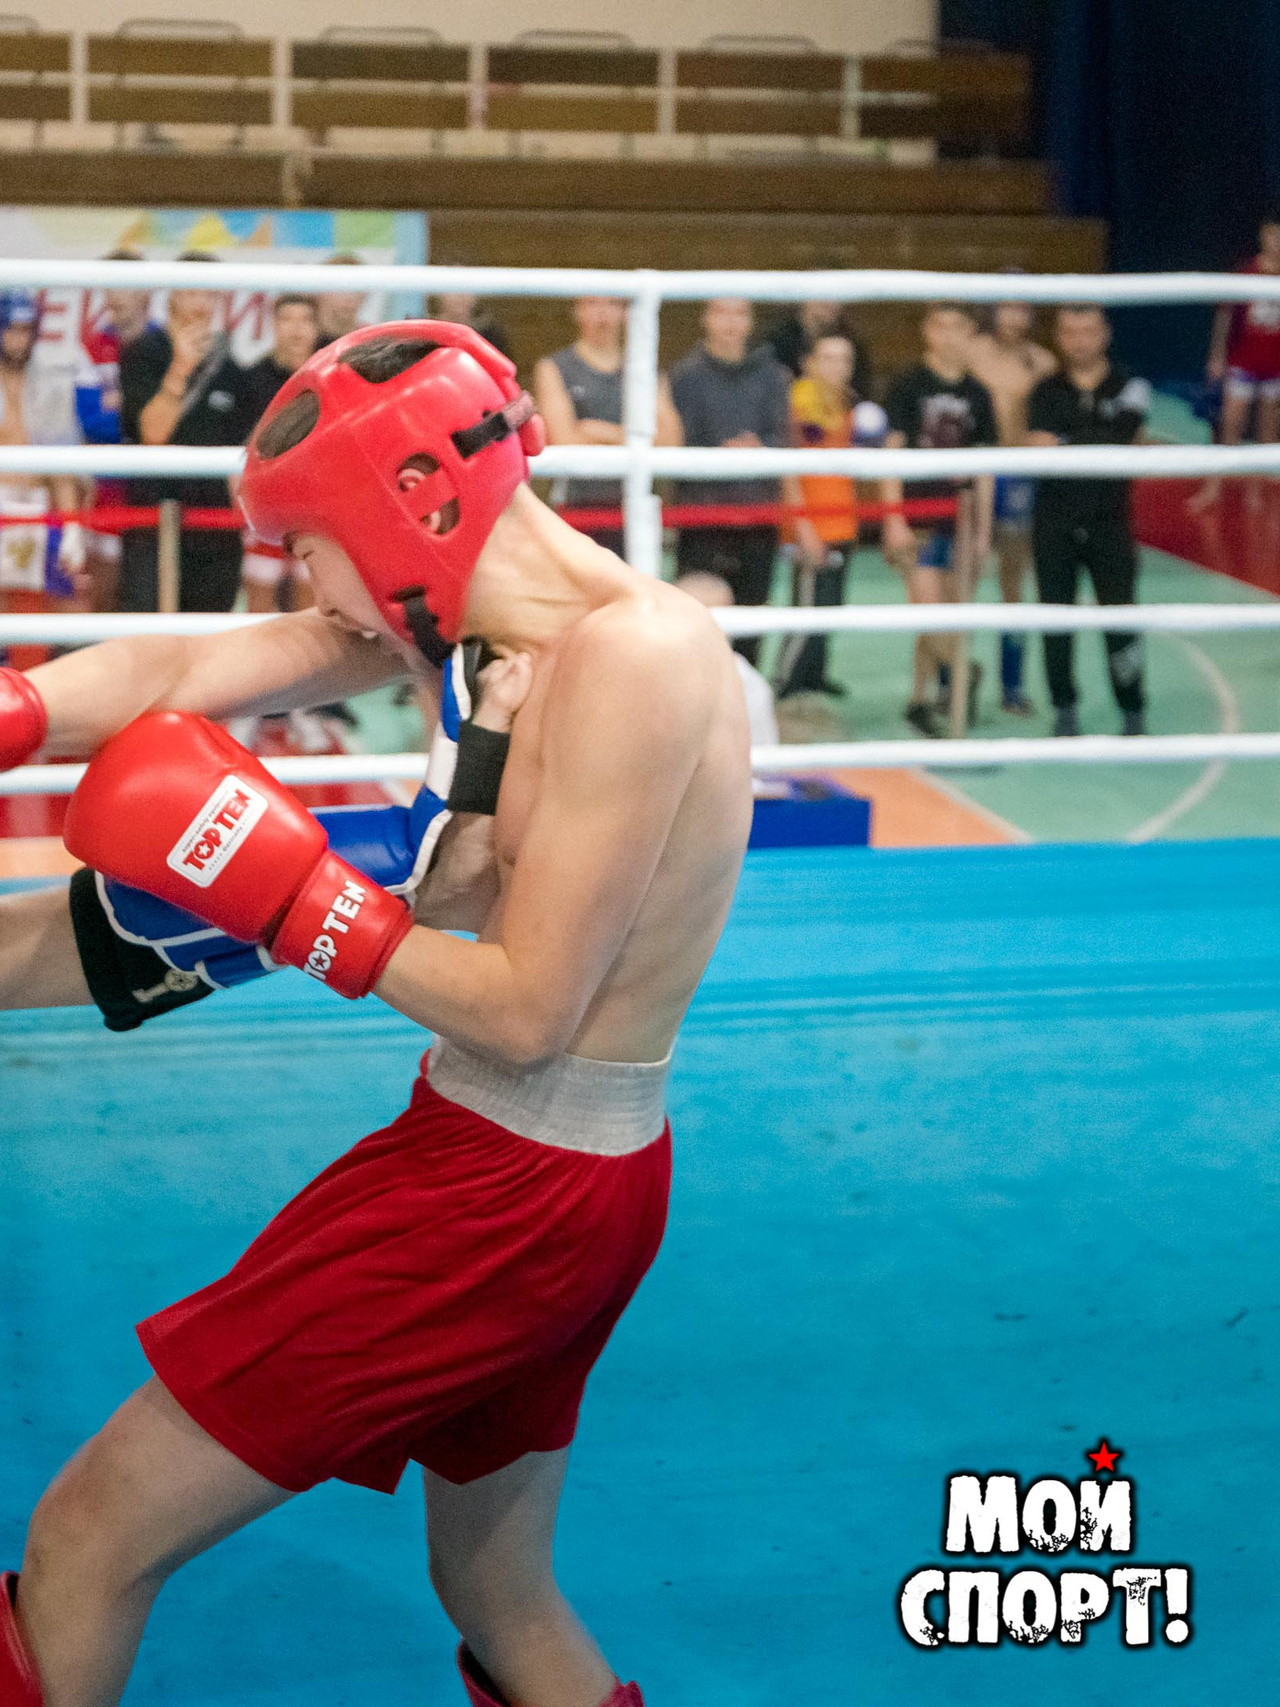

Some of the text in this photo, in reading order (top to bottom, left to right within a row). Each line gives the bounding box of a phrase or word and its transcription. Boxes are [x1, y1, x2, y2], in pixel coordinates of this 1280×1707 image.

[182, 788, 251, 871] TOP TEN
[303, 880, 367, 980] TOP TEN
